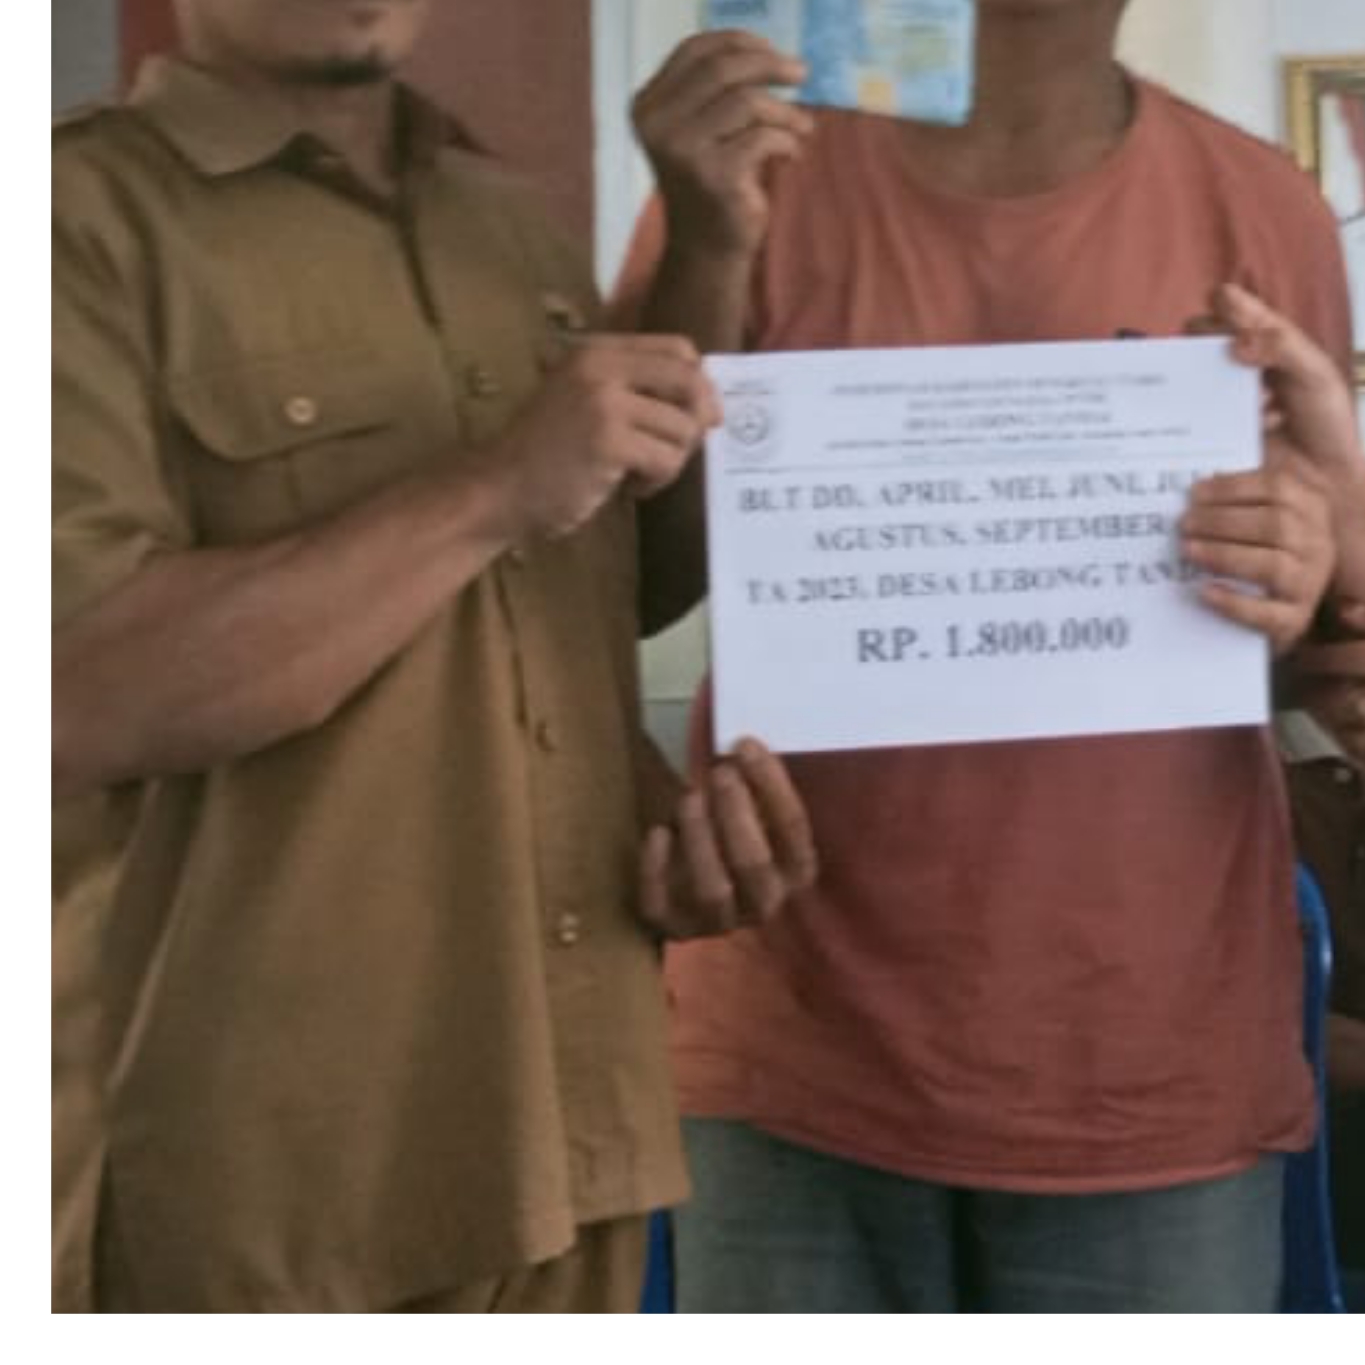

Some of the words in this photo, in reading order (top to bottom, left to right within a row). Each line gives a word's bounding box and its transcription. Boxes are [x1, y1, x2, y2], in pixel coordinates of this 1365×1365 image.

[739, 486, 800, 513] BLT
[747, 579, 788, 604] TA
[877, 571, 961, 599] DESA
[968, 562, 1102, 595] LEBONG
[856, 625, 931, 664] RP.
[945, 616, 1130, 660] 1.800.000
